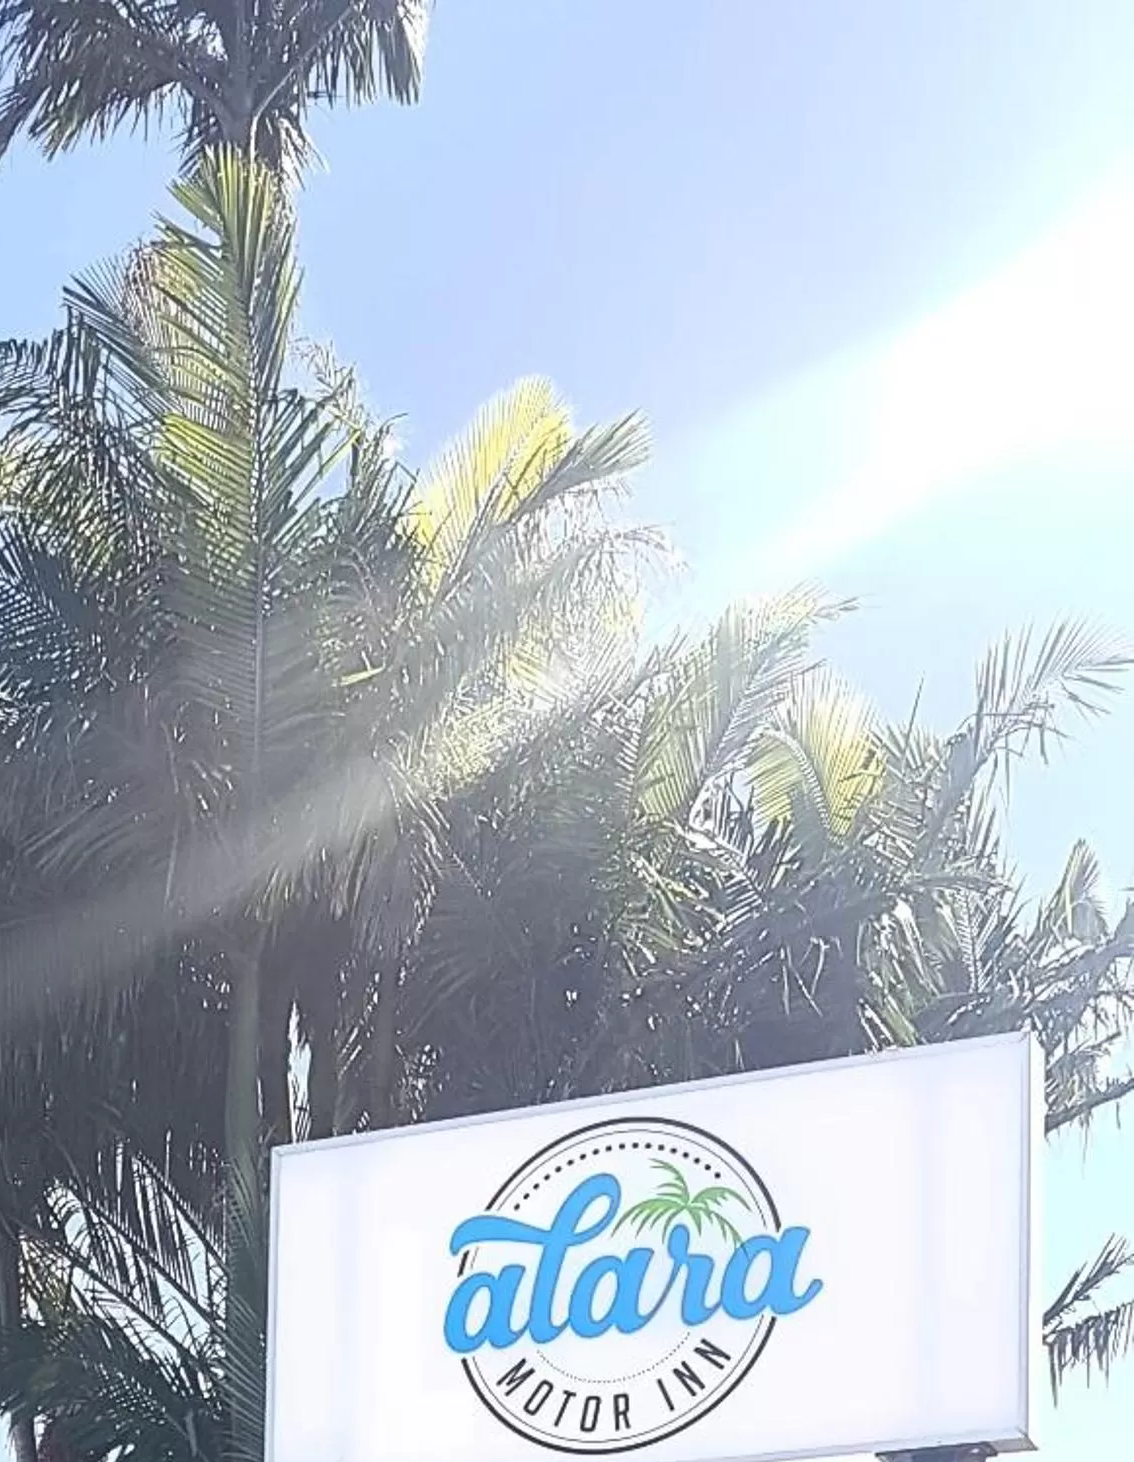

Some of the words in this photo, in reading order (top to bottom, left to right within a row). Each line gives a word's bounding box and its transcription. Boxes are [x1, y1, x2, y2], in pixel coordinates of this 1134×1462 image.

[443, 1172, 823, 1354] alara
[495, 1358, 631, 1433] MOTOR
[656, 1337, 732, 1412] INN
